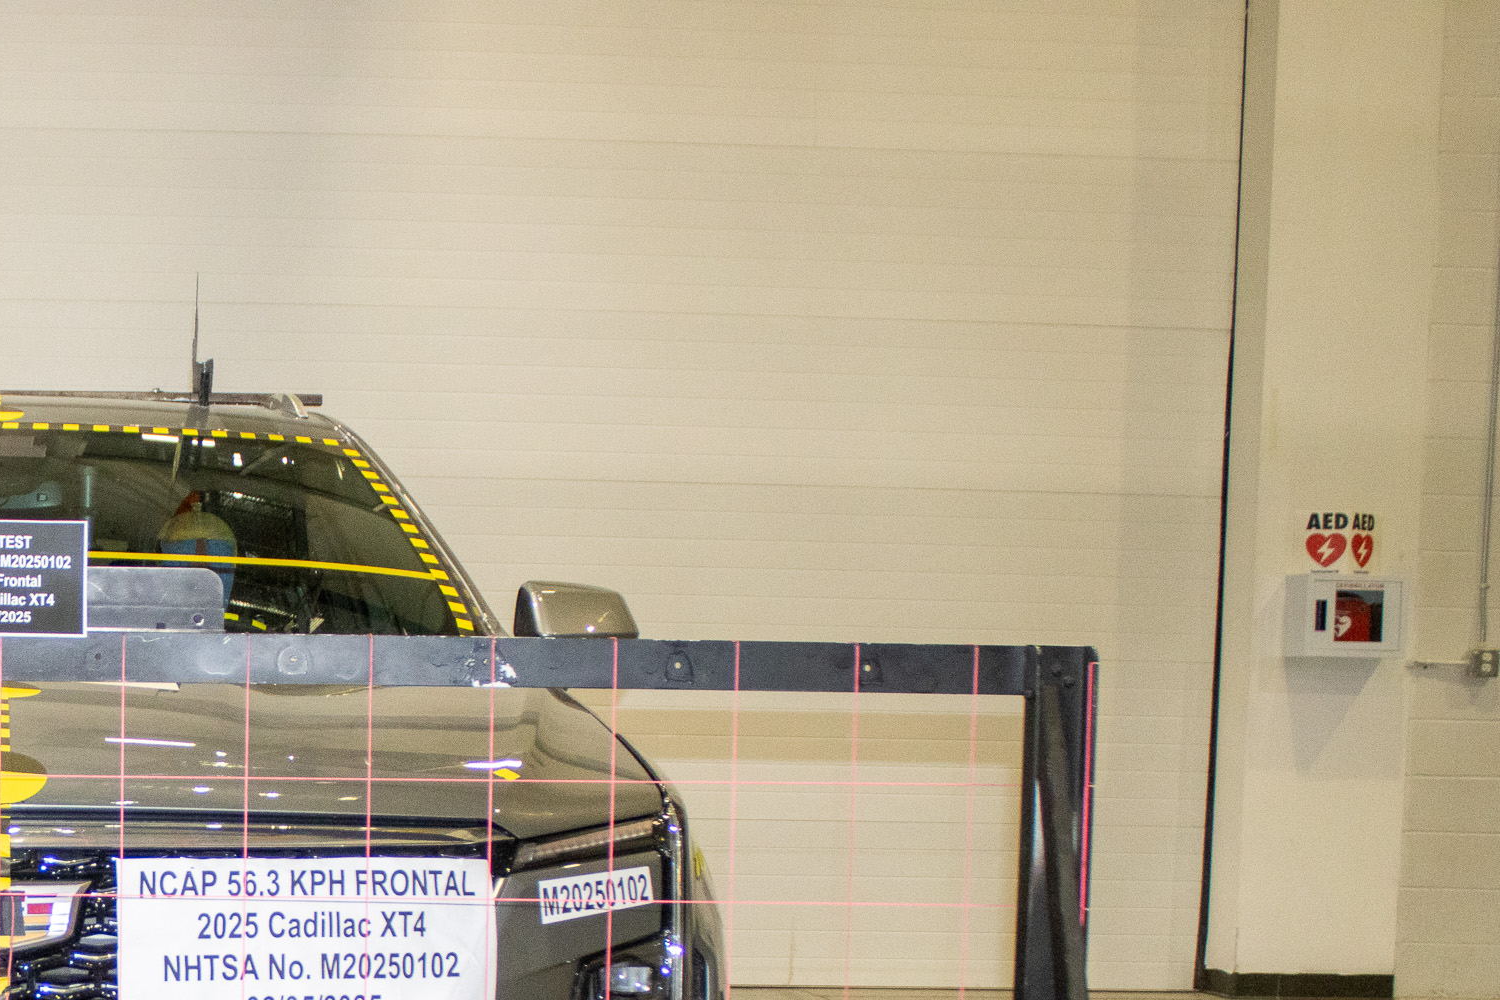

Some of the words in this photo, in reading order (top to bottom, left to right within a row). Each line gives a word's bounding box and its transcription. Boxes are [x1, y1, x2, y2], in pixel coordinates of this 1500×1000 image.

[1306, 512, 1349, 530] AED
[1352, 513, 1375, 531] AED
[0, 555, 72, 569] M20250102
[29, 593, 55, 606] XT4
[139, 870, 217, 899] NCAP
[228, 870, 279, 897] 56.3
[291, 869, 346, 896] KPH
[356, 869, 475, 896] FRONTAL
[542, 874, 650, 916] M20250102
[198, 912, 259, 939] 2025
[268, 911, 372, 938] Cadillac
[381, 911, 427, 937] XT4
[163, 954, 259, 982] NHTSA
[269, 953, 311, 980] No.
[321, 952, 461, 979] M20250102
